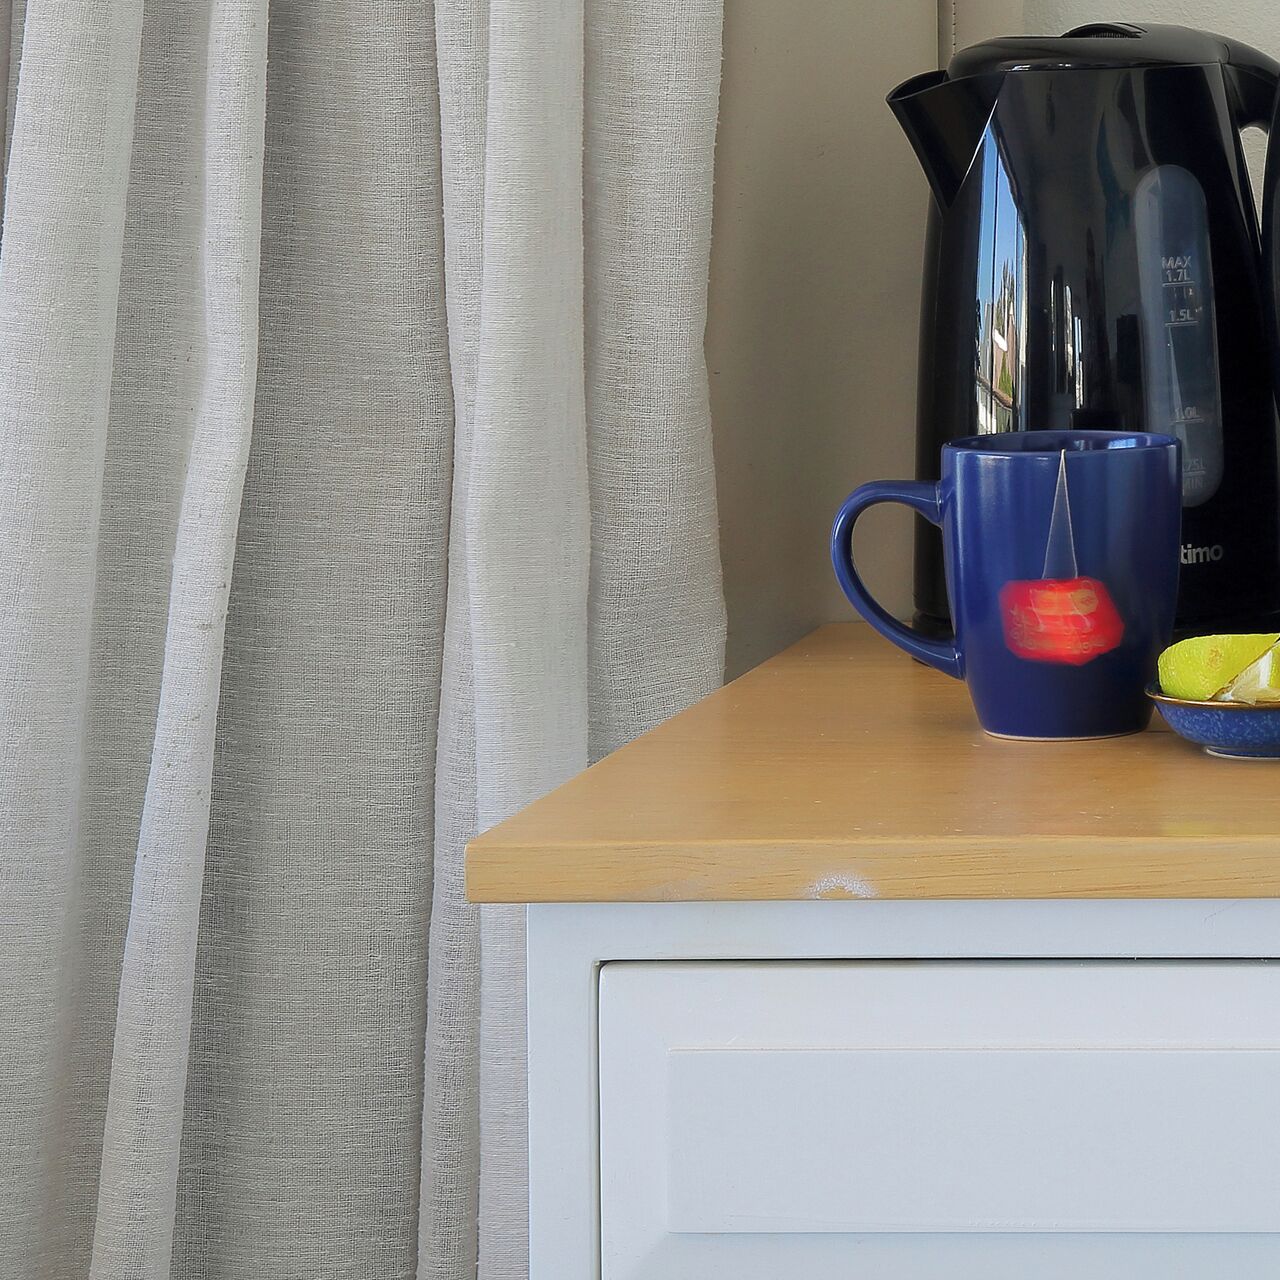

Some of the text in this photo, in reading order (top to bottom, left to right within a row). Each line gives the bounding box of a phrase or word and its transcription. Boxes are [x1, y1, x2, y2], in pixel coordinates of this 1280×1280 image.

[1161, 255, 1192, 269] MAX
[1166, 269, 1191, 282] 1.7L
[1180, 543, 1224, 565] timo
